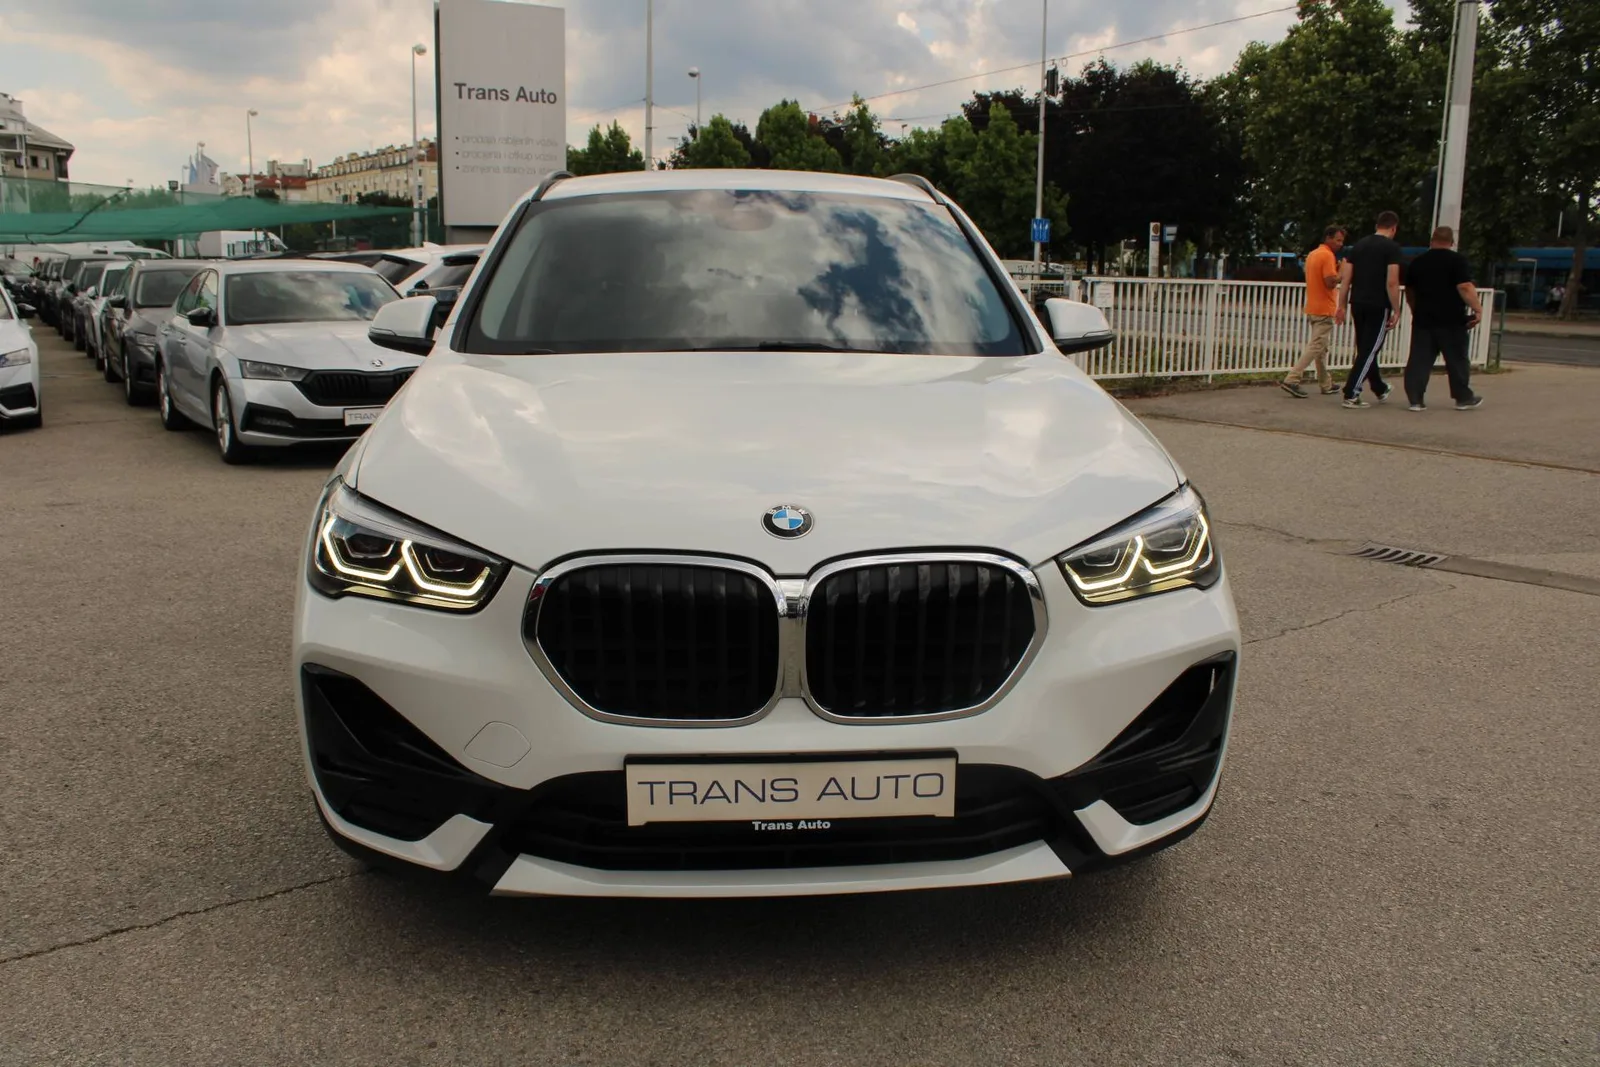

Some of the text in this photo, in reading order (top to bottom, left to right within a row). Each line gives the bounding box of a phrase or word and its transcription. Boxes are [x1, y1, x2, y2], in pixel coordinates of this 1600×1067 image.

[454, 82, 558, 105] Trans Auto
[347, 412, 380, 421] TRAN
[637, 772, 945, 805] TRANS AUTO
[752, 819, 831, 831] Trans Auto
